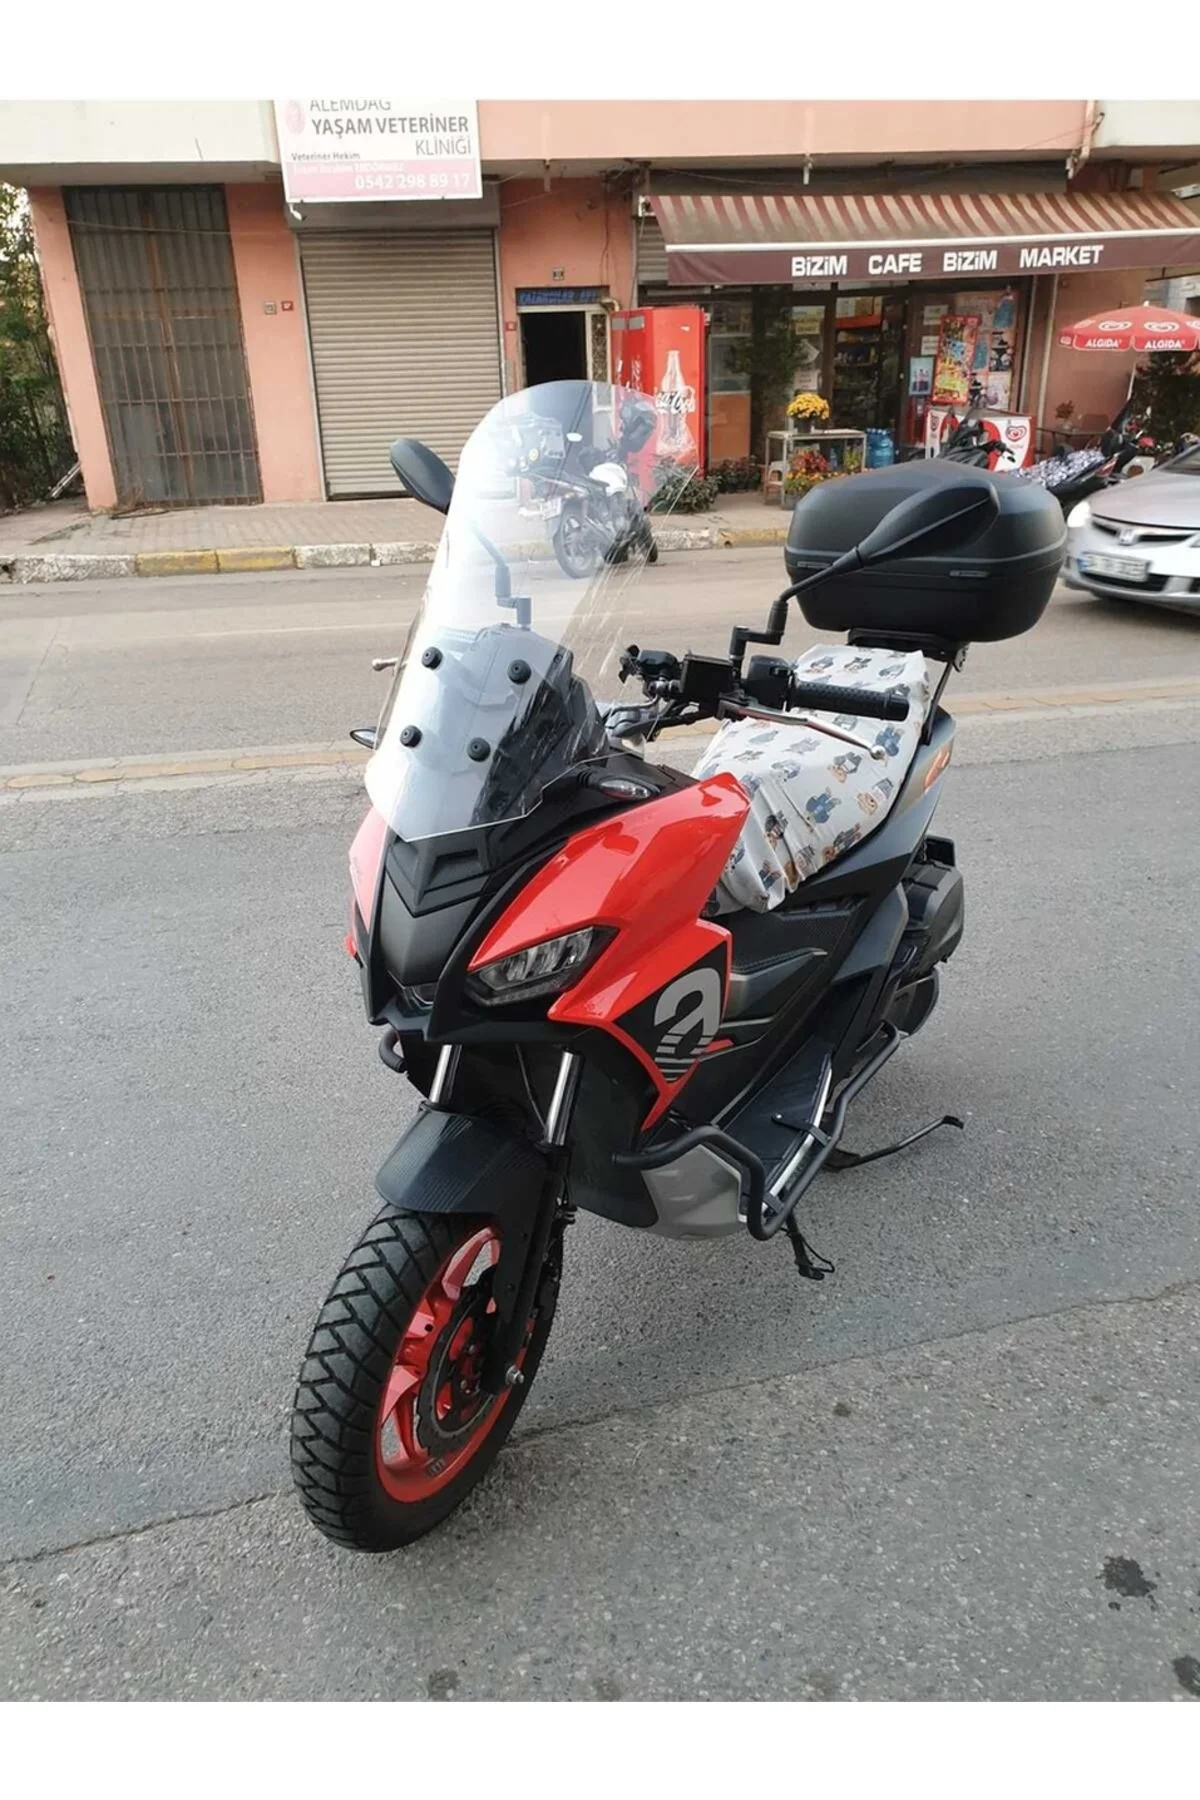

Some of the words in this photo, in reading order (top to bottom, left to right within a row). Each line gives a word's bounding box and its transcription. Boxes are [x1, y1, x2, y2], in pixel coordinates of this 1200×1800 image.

[311, 117, 372, 139] YAŞAM
[375, 113, 469, 134] VETERİNER
[291, 152, 331, 161] Veteriner
[333, 151, 360, 160] Hekim
[415, 135, 472, 157] KLİNİĞİ
[355, 174, 393, 190] 0542
[398, 172, 427, 189] 298
[429, 172, 449, 187] 89
[453, 171, 470, 186] 17
[868, 252, 923, 275] CAFE
[1019, 245, 1104, 269] MARKET
